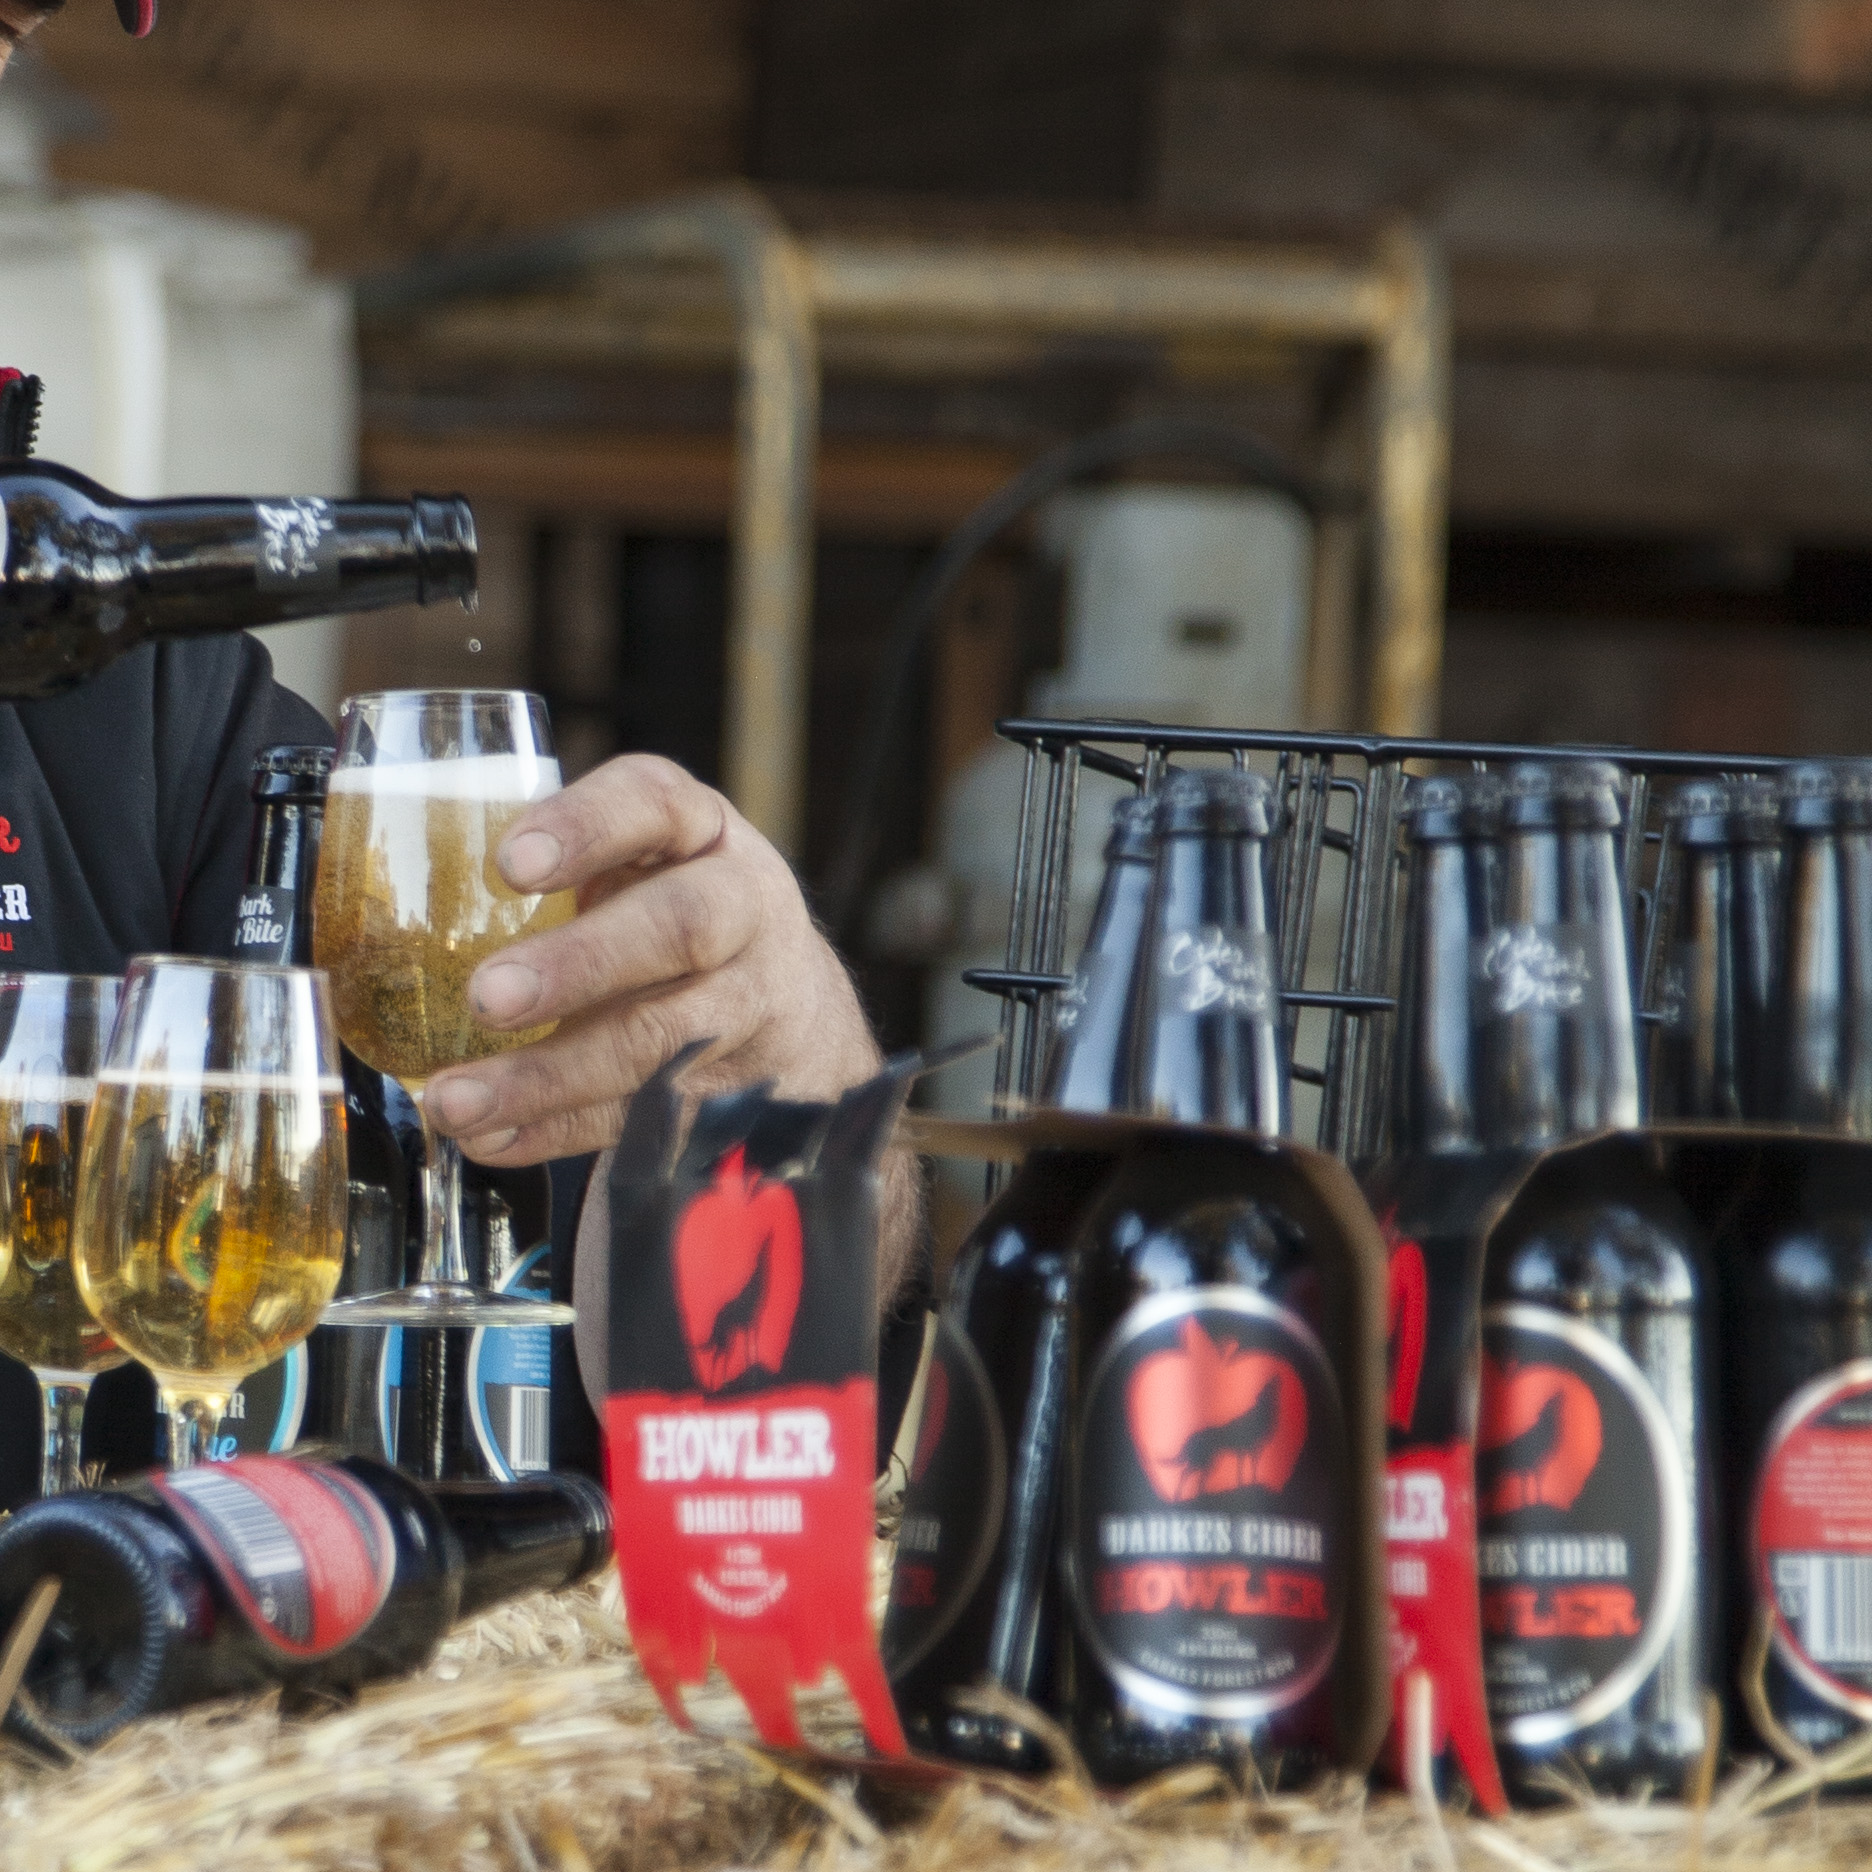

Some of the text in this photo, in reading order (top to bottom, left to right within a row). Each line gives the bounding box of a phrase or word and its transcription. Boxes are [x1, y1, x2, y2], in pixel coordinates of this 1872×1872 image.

[242, 917, 284, 945] Bite
[639, 1409, 835, 1482] HOWLER
[1095, 1561, 1328, 1620] HOWLER
